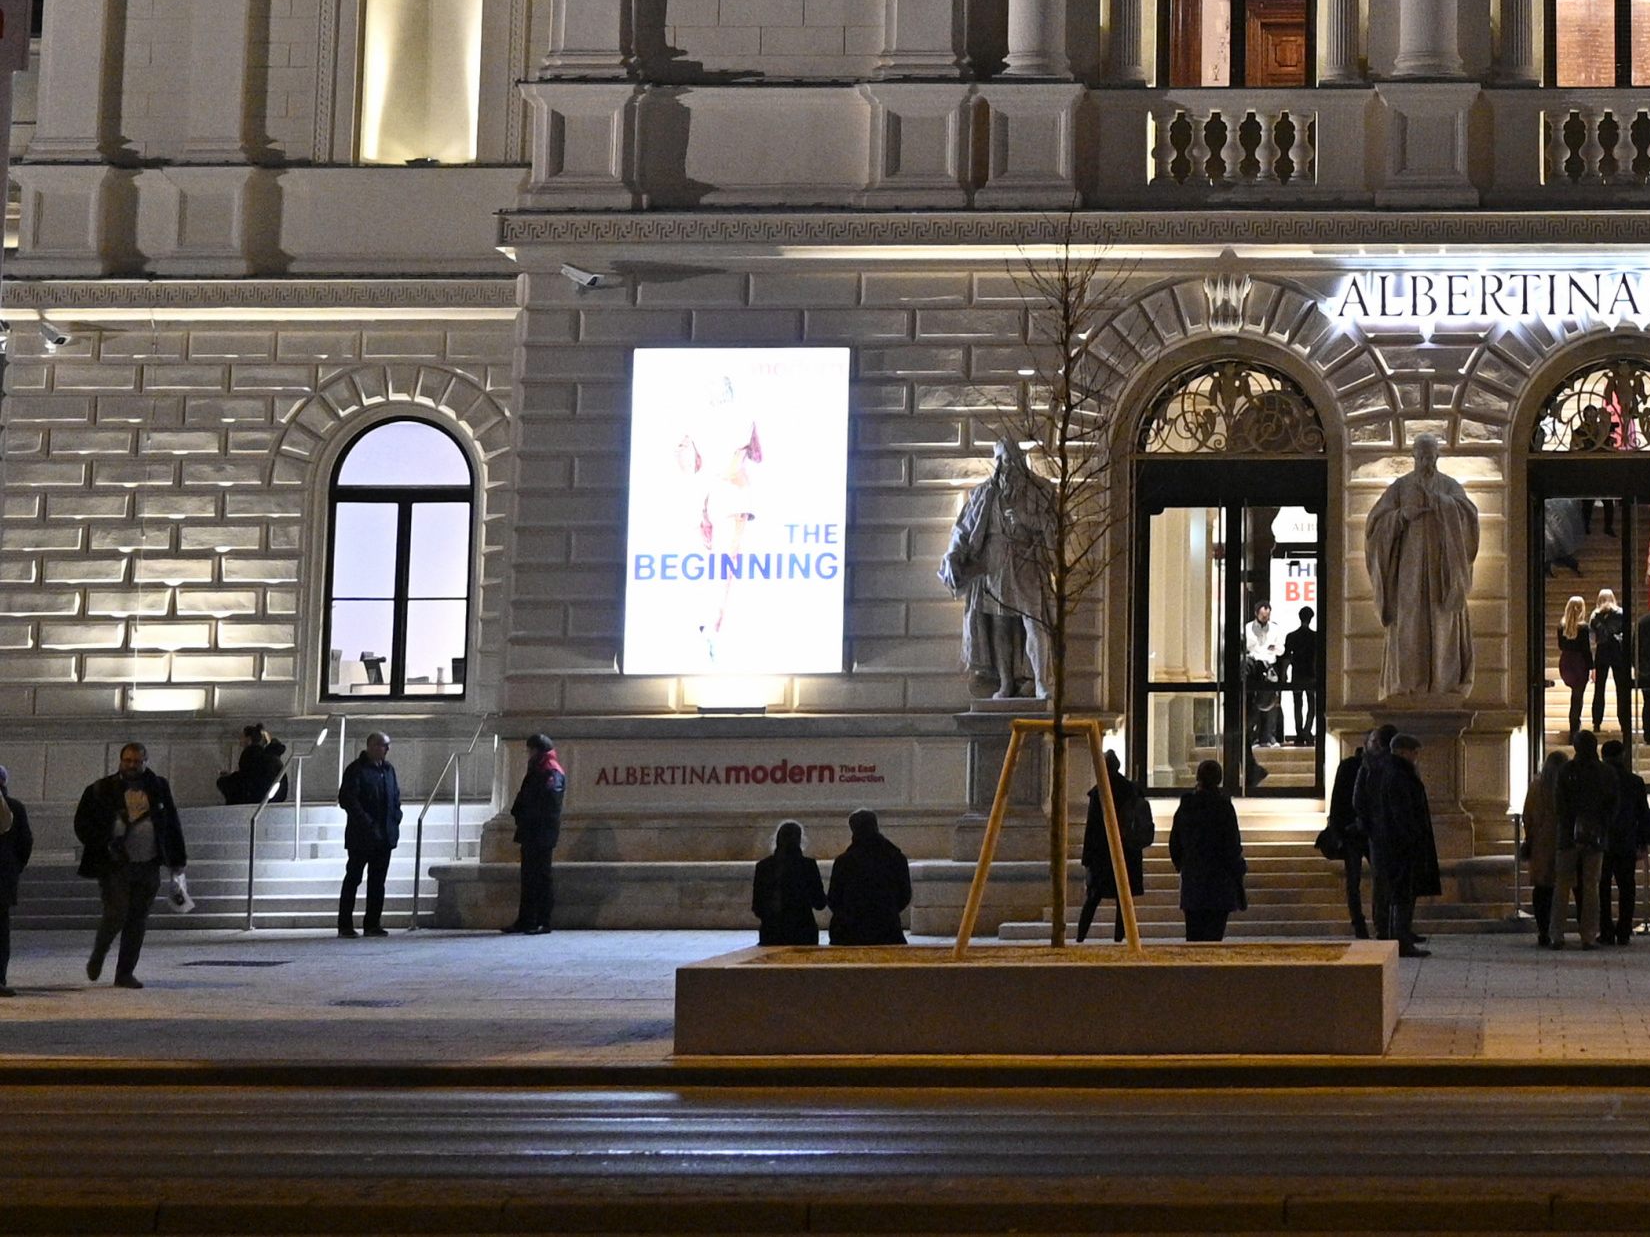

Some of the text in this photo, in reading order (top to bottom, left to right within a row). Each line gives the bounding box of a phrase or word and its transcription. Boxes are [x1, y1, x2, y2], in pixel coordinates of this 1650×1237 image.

[1336, 273, 1643, 317] ALBERTINA
[784, 524, 838, 544] THE
[634, 552, 838, 581] BEGINNING
[595, 765, 721, 785] ALBERTINA
[724, 759, 835, 784] modern
[838, 774, 885, 783] Collection
